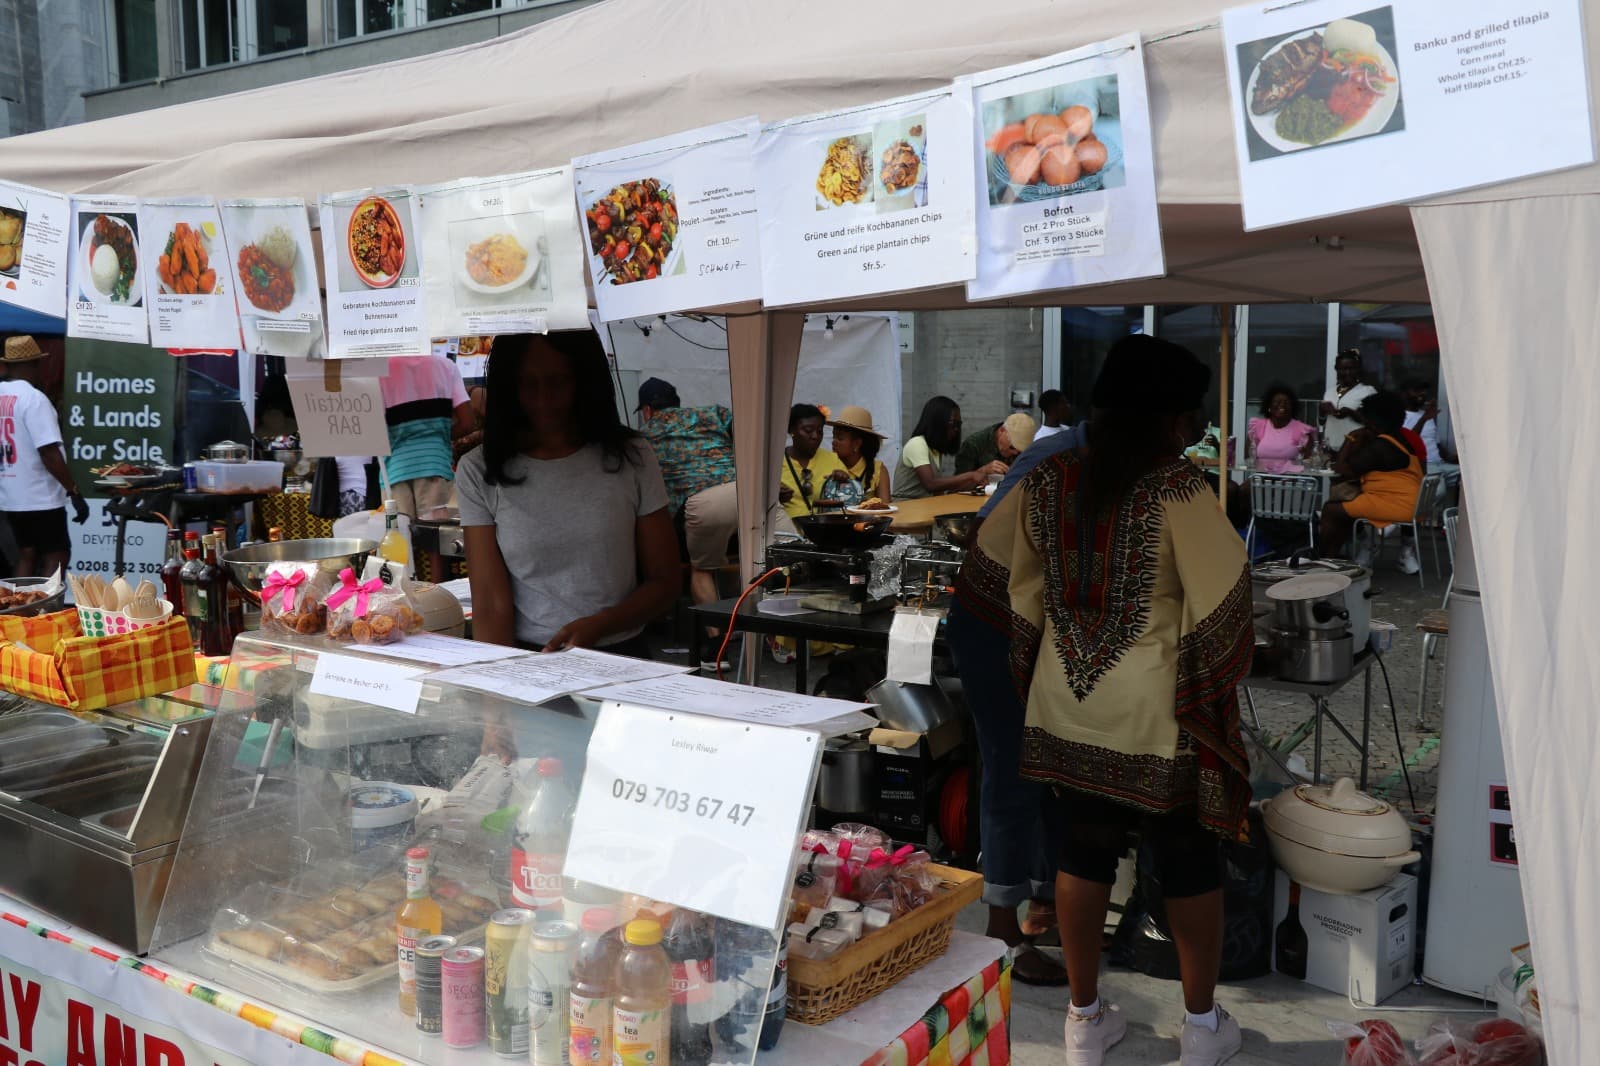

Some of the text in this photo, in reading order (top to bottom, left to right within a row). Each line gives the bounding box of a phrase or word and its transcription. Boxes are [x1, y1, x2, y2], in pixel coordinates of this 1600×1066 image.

[1414, 11, 1549, 51] Banku and grilled tilapia
[1457, 38, 1506, 55] Ingredients
[1460, 49, 1505, 66] Corn meal
[1438, 72, 1466, 84] Whole
[1468, 65, 1495, 79] tilapia
[1445, 84, 1462, 95] Half
[1464, 78, 1491, 91] tilapia
[1044, 205, 1074, 217] Bofrot
[680, 217, 700, 226] Poulet
[805, 212, 942, 241] Grüne und reife Kochbananen Chips
[1023, 216, 1091, 233] Chf. 2 Pro Stück
[817, 234, 930, 258] Green and ripe plantain chips
[1025, 238, 1042, 247] Chf.
[1044, 236, 1050, 244] 5
[1051, 234, 1066, 244] pro
[1075, 228, 1104, 239] Stücke
[863, 261, 886, 271] Sfr.5.-
[342, 302, 370, 310] Gebratene
[358, 328, 369, 336] ripe
[370, 326, 393, 335] plantains
[76, 371, 156, 394] Homes
[69, 404, 161, 428] & Lands
[72, 436, 163, 461] for Sale
[82, 534, 144, 546] DEVTRCO
[76, 560, 109, 572] 0208
[671, 738, 694, 752] Lesley
[612, 778, 755, 826] 079 703 67 47
[1320, 921, 1354, 937] PROSECCO
[574, 1008, 584, 1020] tea
[624, 1026, 638, 1036] tea
